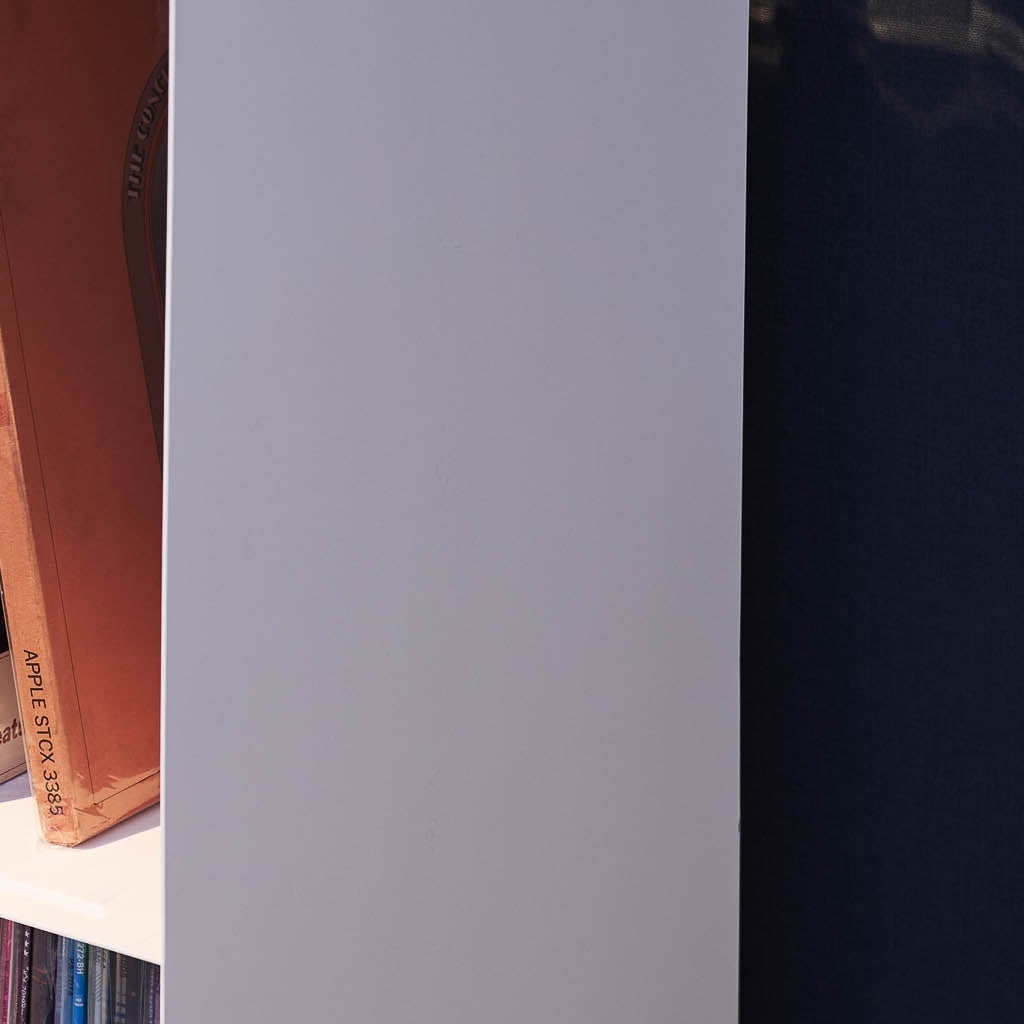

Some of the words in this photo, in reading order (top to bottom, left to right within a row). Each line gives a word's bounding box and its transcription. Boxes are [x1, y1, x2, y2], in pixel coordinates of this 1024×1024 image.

[127, 144, 146, 199] THE
[23, 649, 47, 710] APPLE
[34, 714, 56, 764] STCX
[43, 769, 65, 816] 3385
